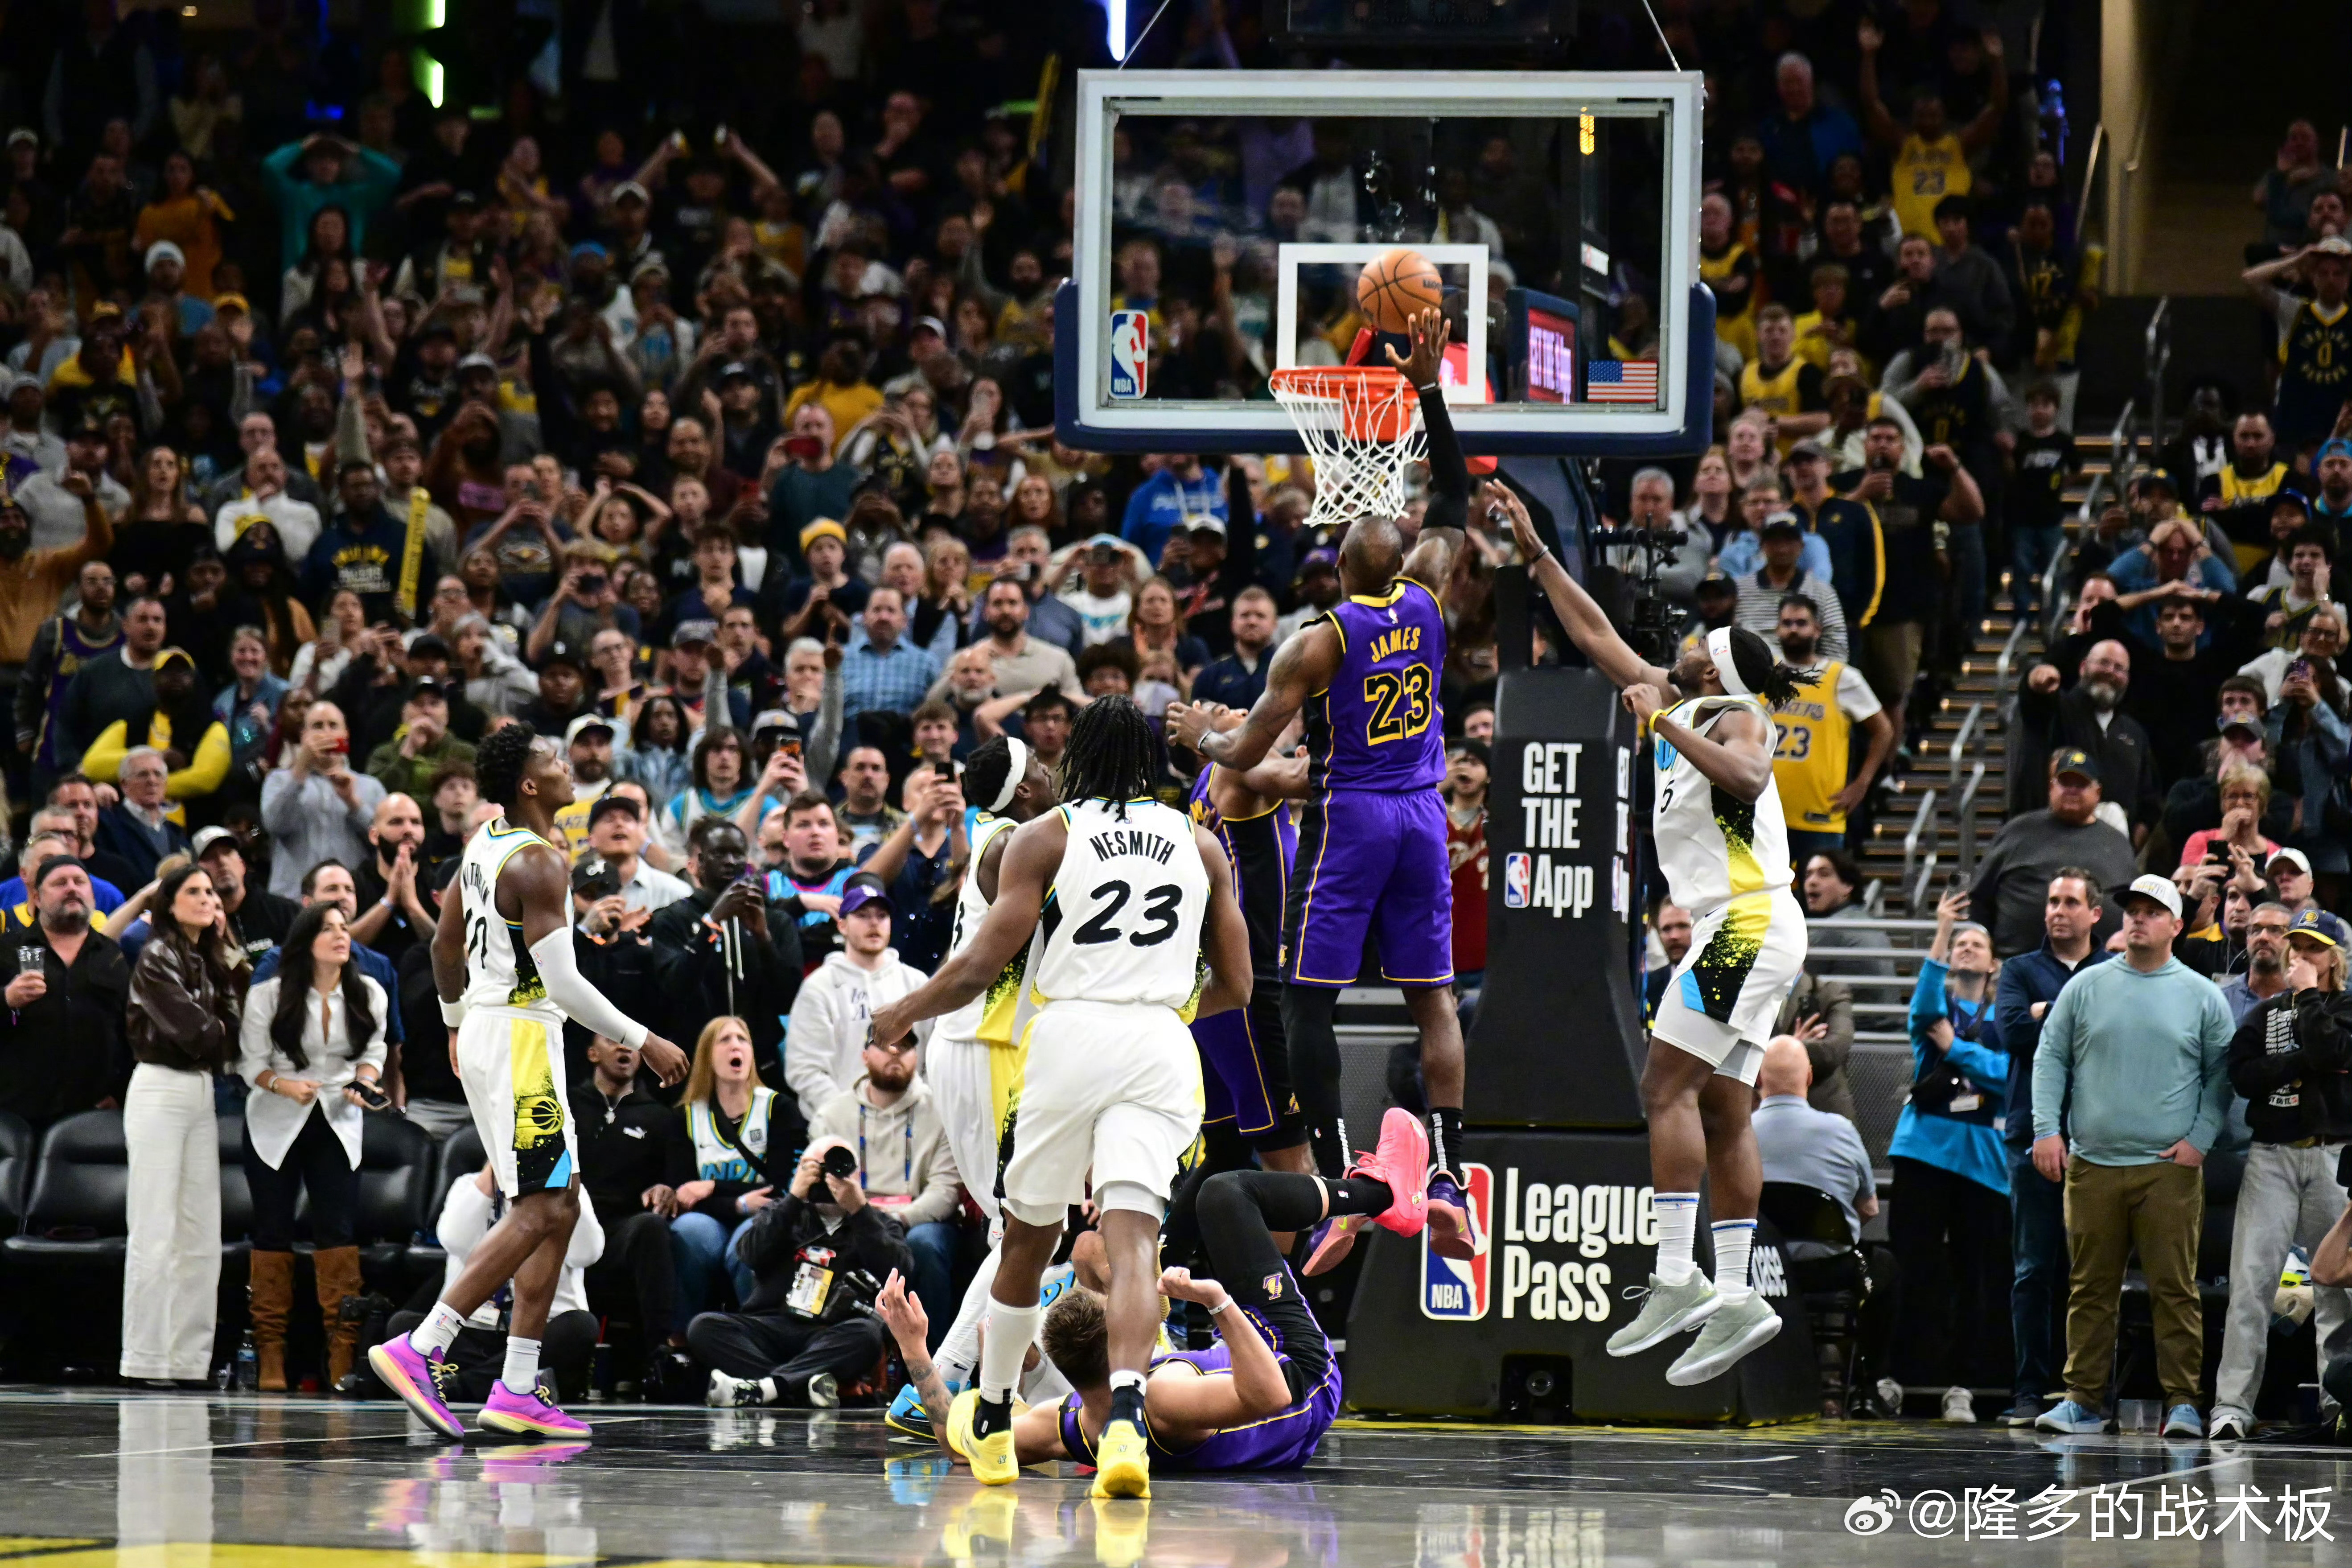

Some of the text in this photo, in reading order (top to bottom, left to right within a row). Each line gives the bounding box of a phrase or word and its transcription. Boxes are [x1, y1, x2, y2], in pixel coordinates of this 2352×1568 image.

[1114, 379, 1132, 393] NBA
[1370, 626, 1421, 663] JAMES
[1364, 663, 1432, 746] 23
[1522, 741, 1583, 794] GET
[1771, 724, 1812, 760] 23
[1089, 830, 1176, 866] NESMITH
[1521, 797, 1582, 849] THE
[1532, 854, 1594, 919] App
[1073, 880, 1183, 948] 23
[1505, 1167, 1661, 1259] League
[1431, 1284, 1464, 1309] NBA
[1502, 1245, 1612, 1322] Pass
